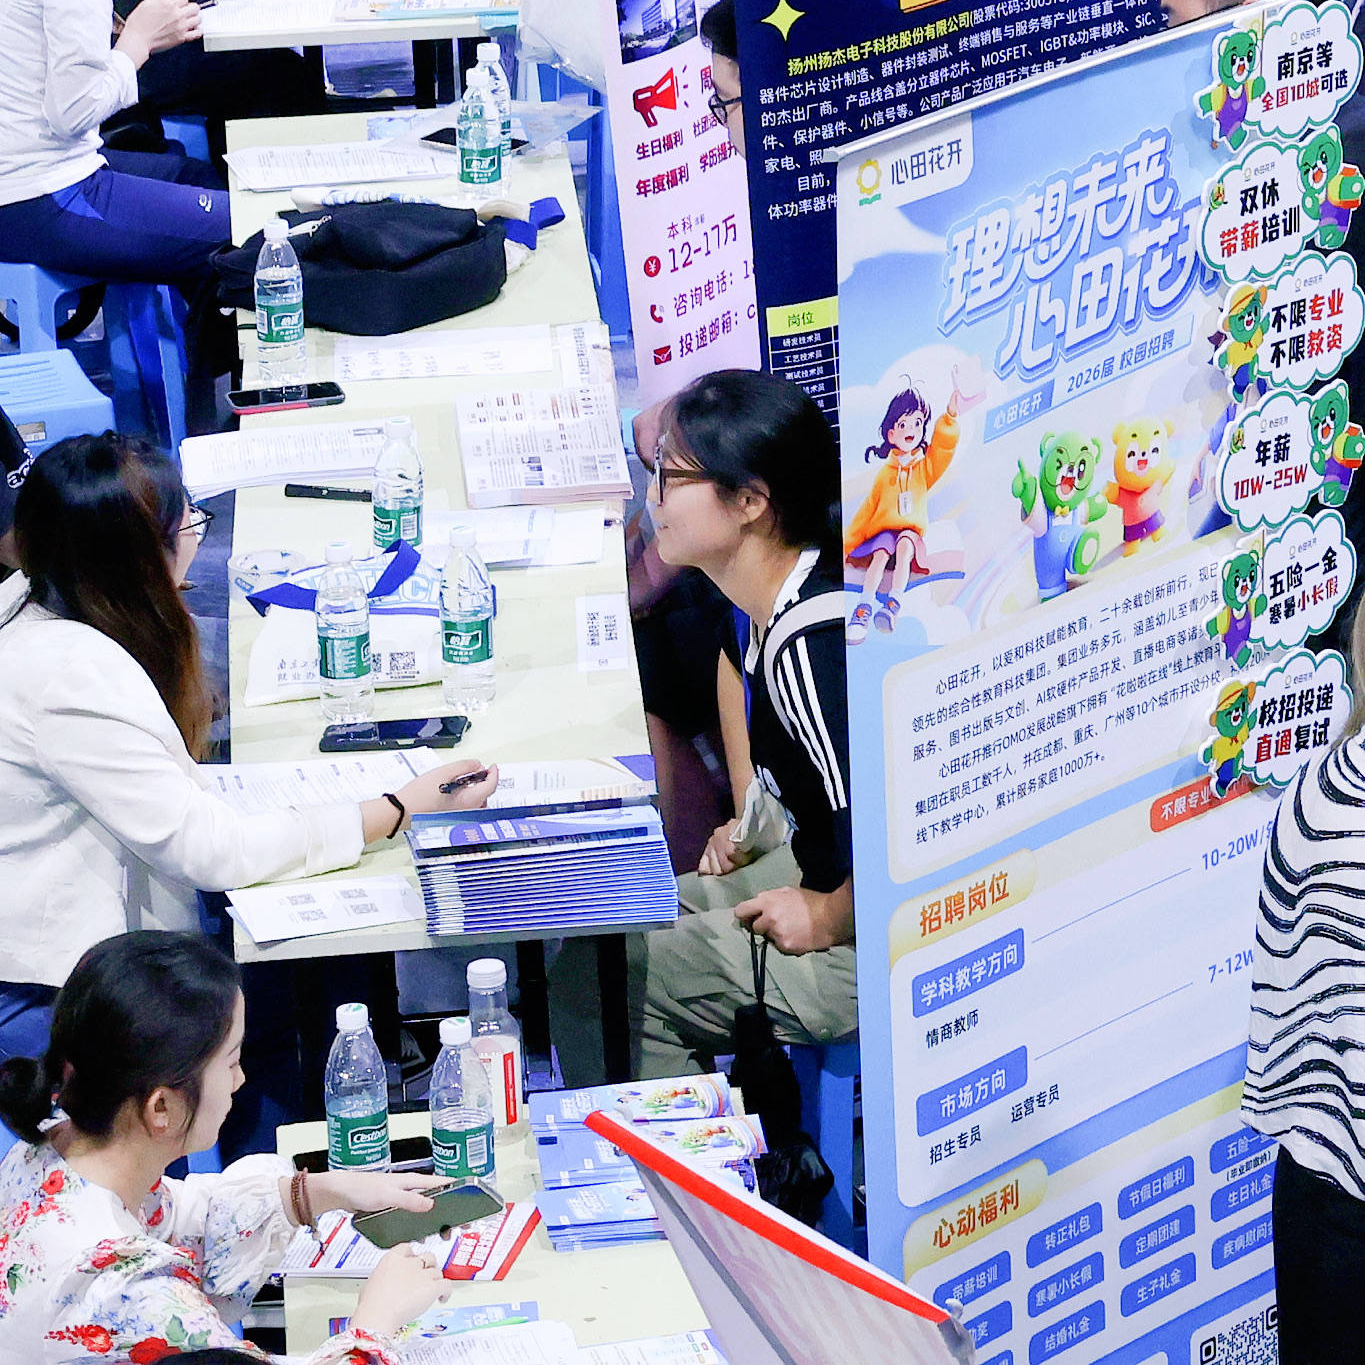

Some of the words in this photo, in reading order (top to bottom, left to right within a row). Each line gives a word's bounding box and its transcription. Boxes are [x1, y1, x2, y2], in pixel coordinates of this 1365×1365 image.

[1277, 40, 1334, 81] 南京等
[1261, 69, 1349, 113] 全国10城可选
[635, 129, 683, 162] 生日福利
[764, 146, 834, 174] 家电、照
[891, 138, 963, 186] 心田花开
[635, 162, 690, 199] 年度福利
[1239, 178, 1281, 217] 双休
[667, 221, 693, 242] 本科
[667, 214, 737, 276] 12-17万
[944, 133, 1173, 321] 理想未来
[1219, 206, 1301, 259] 带薪培训
[787, 311, 815, 328] 岗位
[1271, 287, 1344, 333] 不限专业
[1068, 359, 1117, 393] 2026届
[1119, 330, 1176, 375] 校园招聘
[1270, 323, 1343, 368] 不限教资
[993, 395, 1044, 427] 心田花开
[1255, 432, 1291, 468] 年薪
[1233, 463, 1308, 501] 10W-25W
[1268, 546, 1339, 601] 五险一金
[1268, 575, 1339, 626] 寒暑小长假
[1258, 681, 1335, 730] 校招投递
[1255, 718, 1331, 765] 直通复试
[918, 869, 1011, 939] 招聘岗位
[920, 938, 1019, 1008] 学科教学方向
[925, 1008, 980, 1051] 情商教师
[939, 1067, 1008, 1119] 市场方向
[1010, 1083, 1061, 1124] 运营专员
[929, 1124, 983, 1166] 招生专员
[1128, 1164, 1187, 1209] 节假日福利
[1228, 1172, 1274, 1208] 生日礼金
[932, 1178, 1020, 1251] 心动福利
[1044, 1214, 1092, 1252] 转正礼包
[1135, 1217, 1182, 1256] 定期团建
[1034, 1266, 1094, 1309] 寒暑小长假
[1136, 1267, 1182, 1304] 生子礼金
[1043, 1316, 1091, 1353] 结婚礼金
